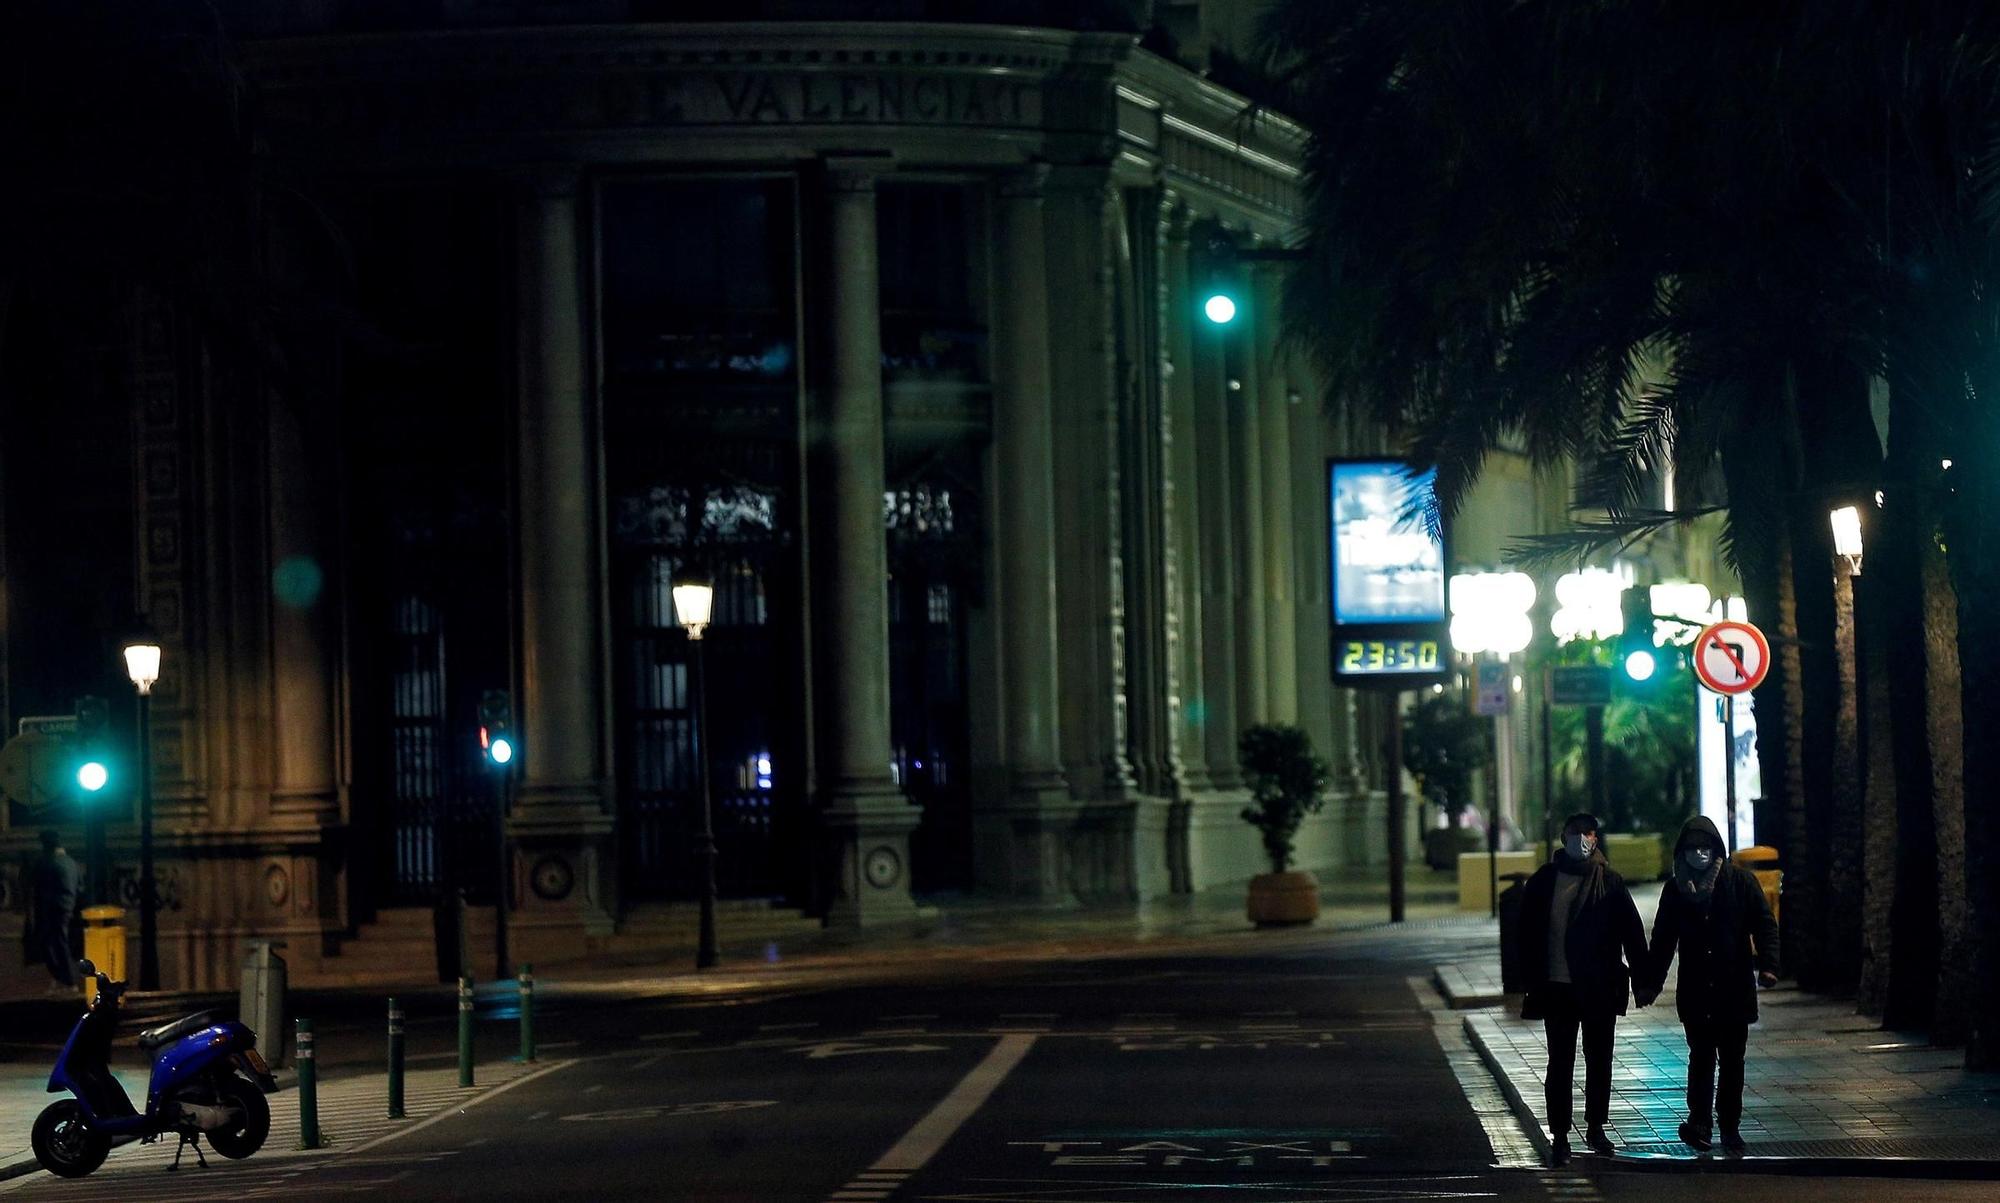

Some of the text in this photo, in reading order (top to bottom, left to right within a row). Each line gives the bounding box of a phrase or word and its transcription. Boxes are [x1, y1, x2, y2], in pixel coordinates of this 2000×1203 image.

[1344, 642, 1437, 669] 23:50
[1007, 1140, 1352, 1152] TAXI
[1051, 1155, 1368, 1167] EMT
